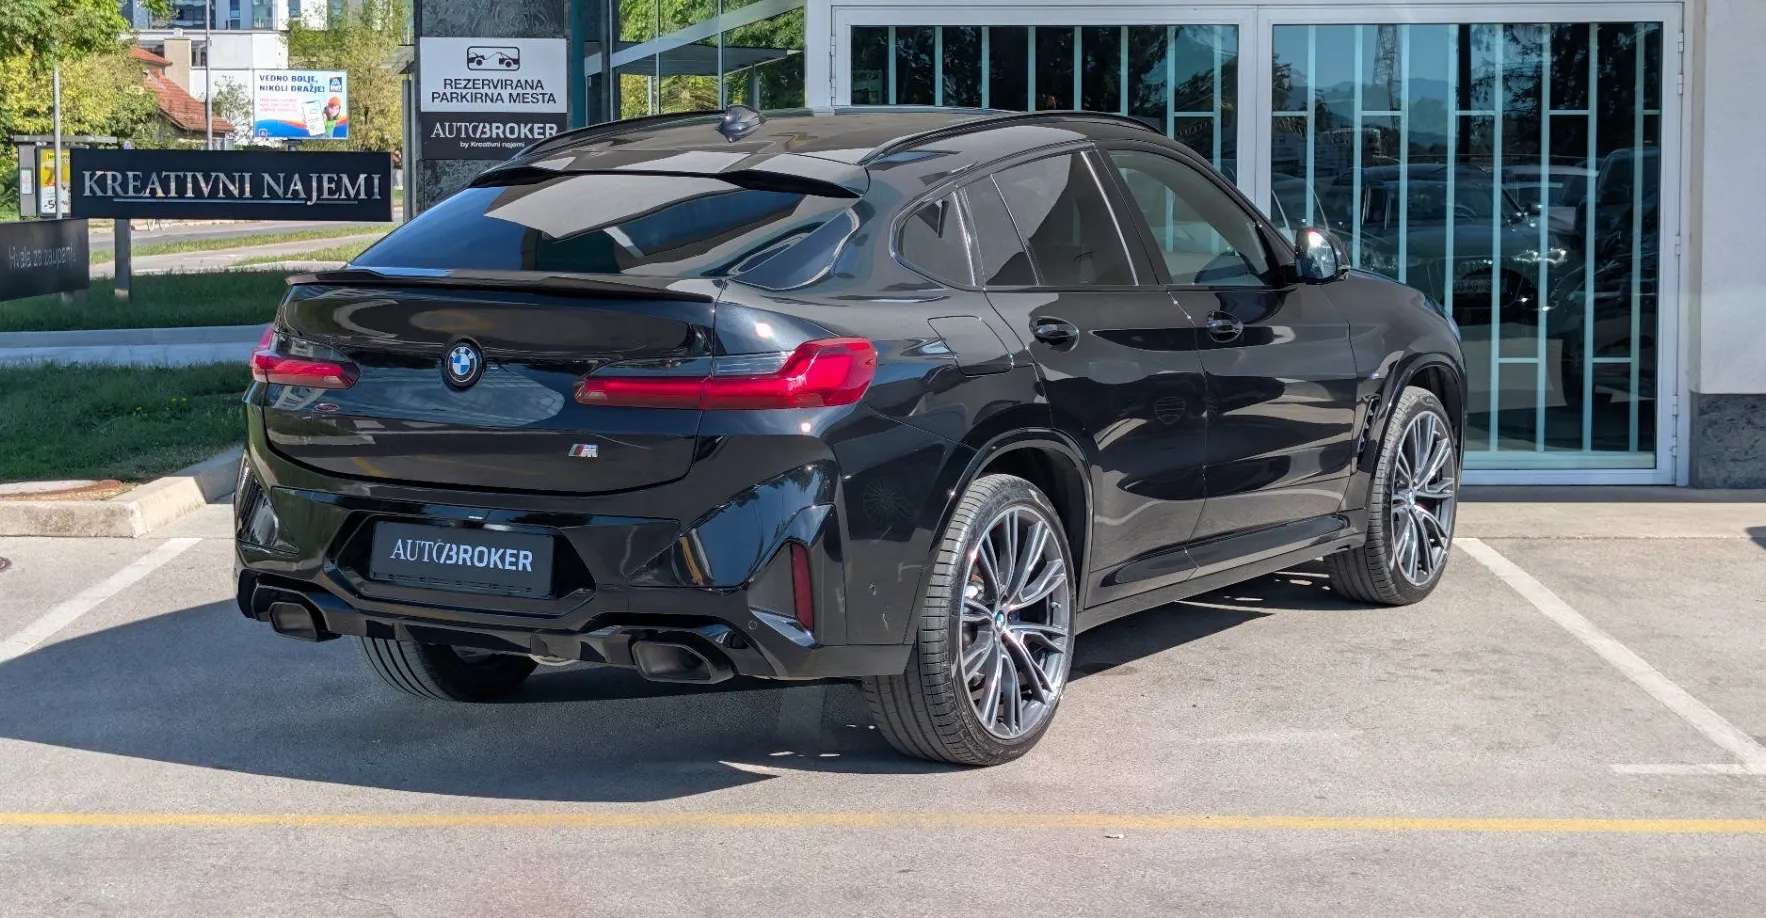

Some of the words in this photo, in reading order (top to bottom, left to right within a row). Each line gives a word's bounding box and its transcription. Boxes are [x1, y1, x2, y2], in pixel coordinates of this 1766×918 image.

[291, 75, 319, 83] BOLJE,
[443, 78, 544, 91] REZERVIRANA
[259, 84, 288, 92] NIKOLI
[291, 83, 325, 93] DRAŽJE!
[431, 91, 505, 104] PARKIRNA
[508, 92, 557, 104] MESTA
[460, 141, 469, 149] by
[501, 141, 526, 149] najemi
[82, 170, 253, 198] KREATIVNI
[261, 173, 382, 205] NAJEMI
